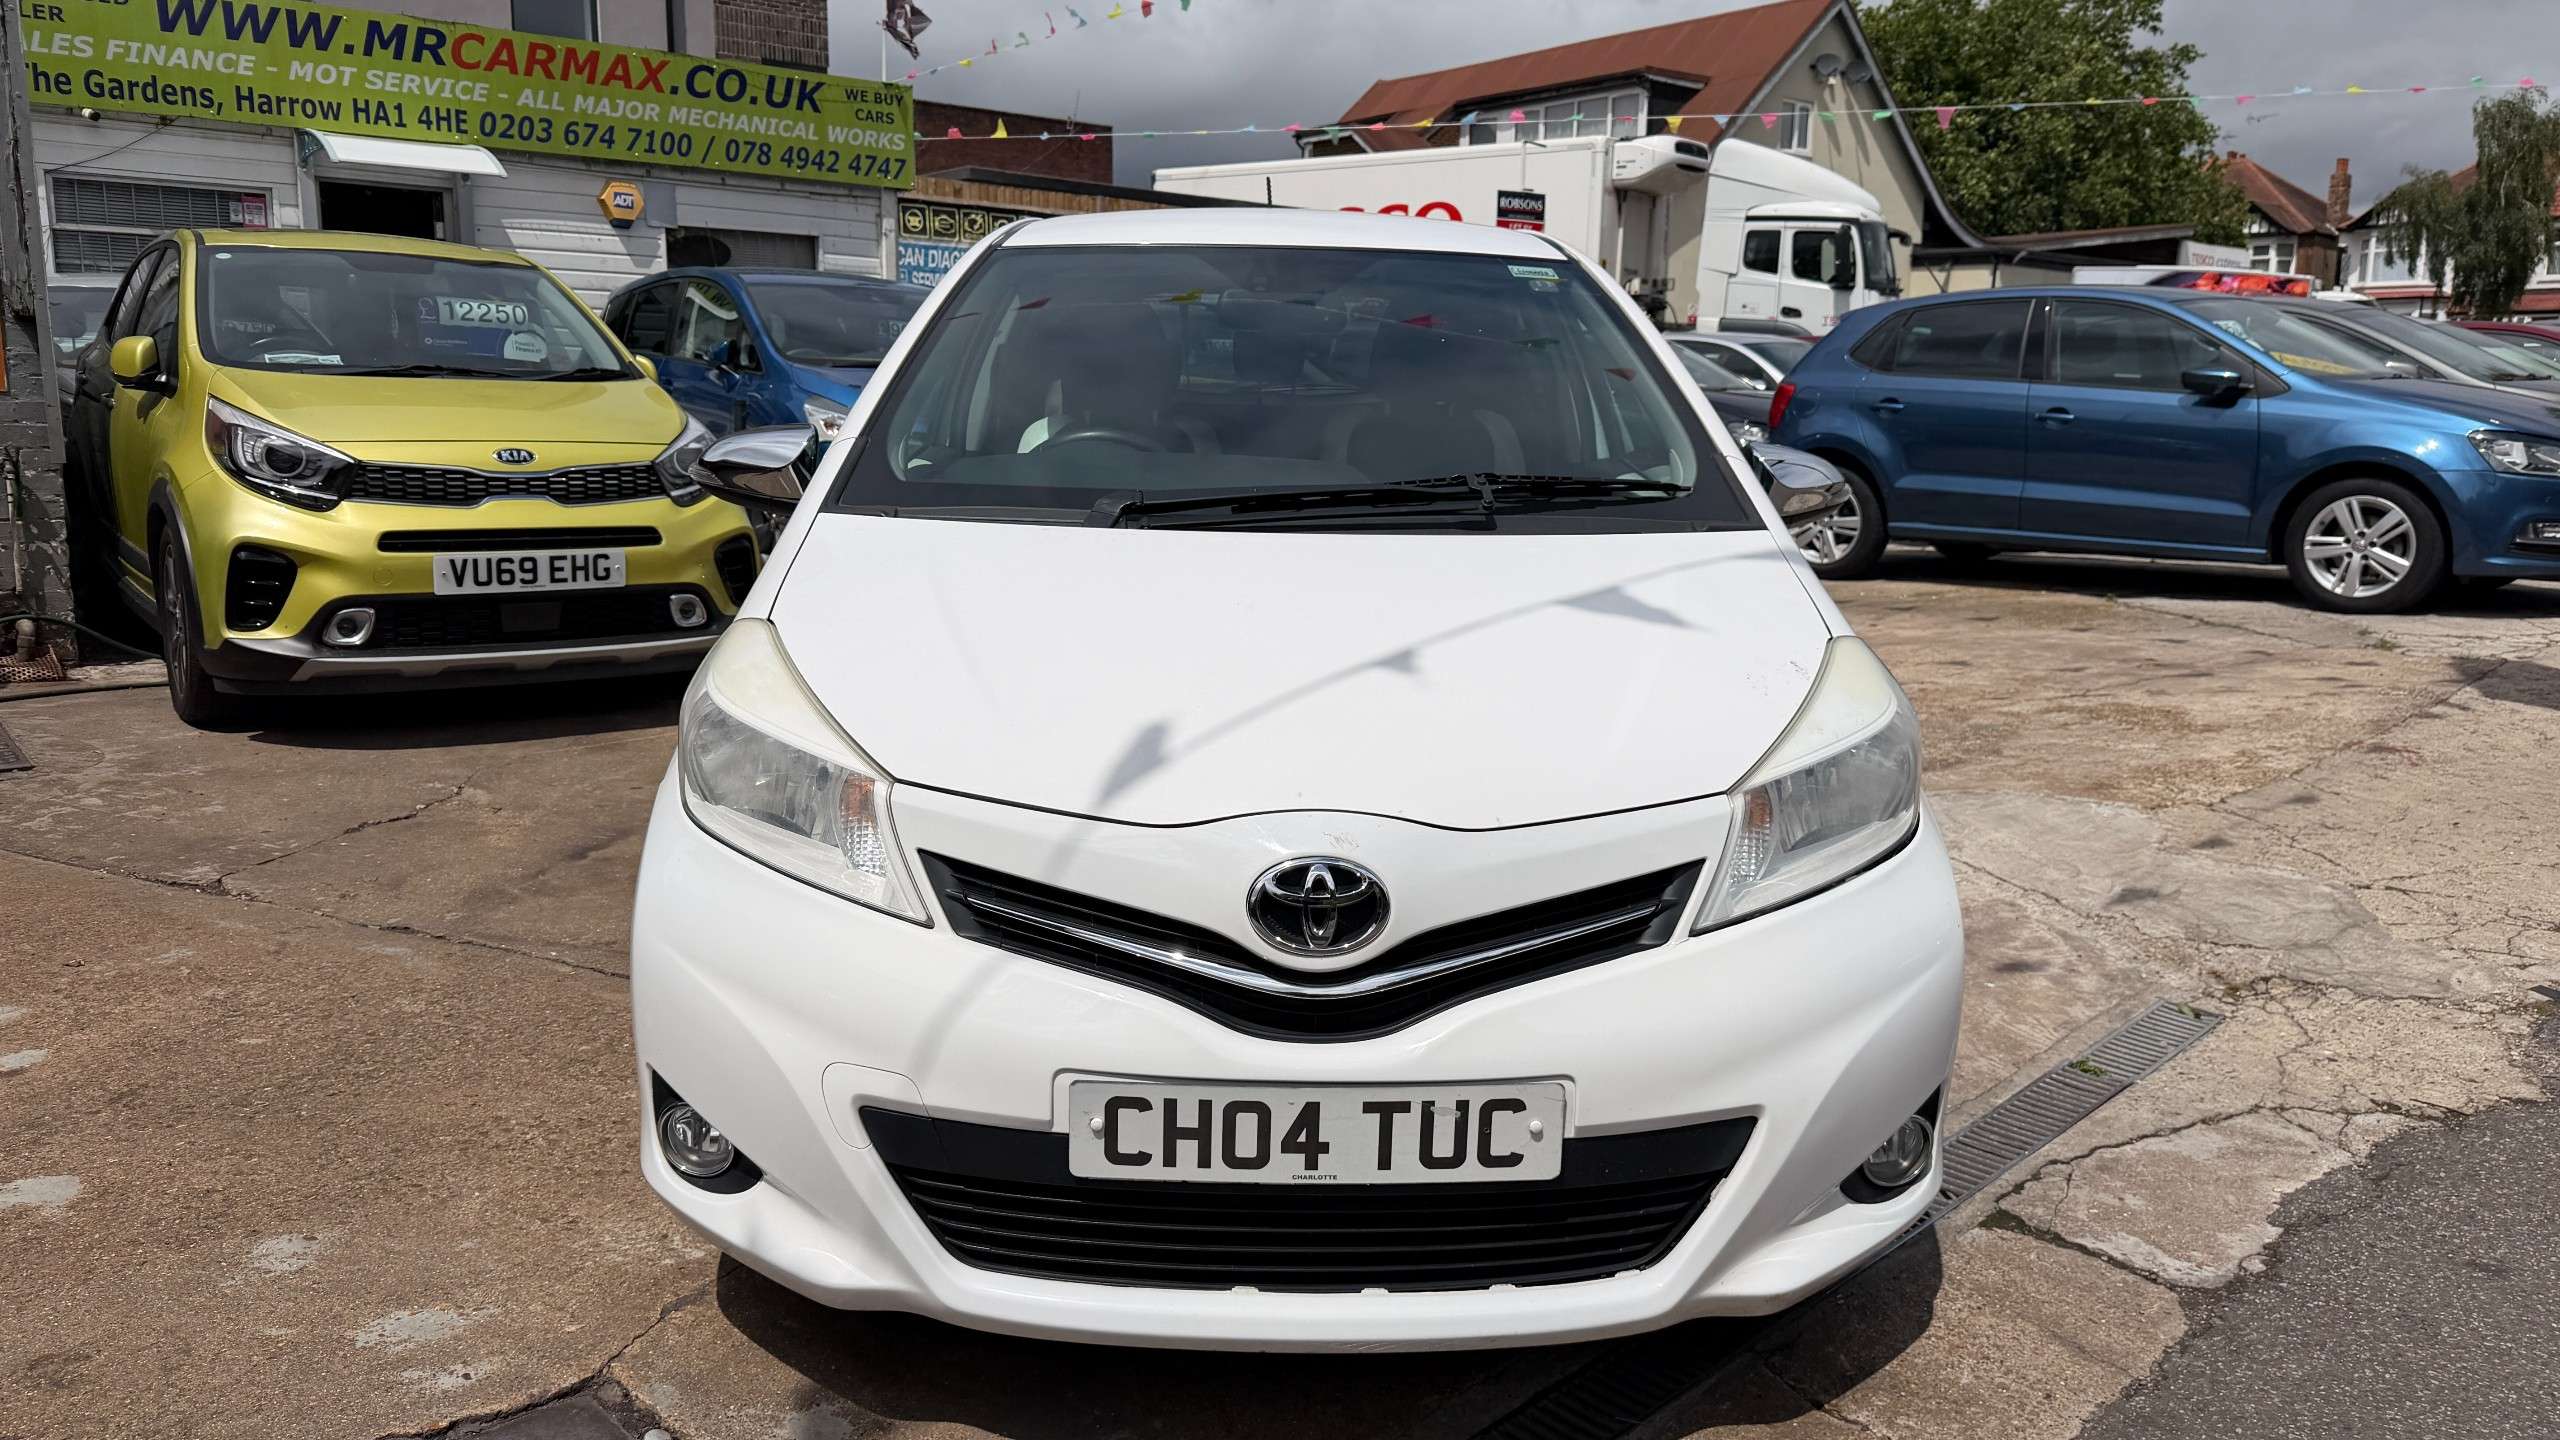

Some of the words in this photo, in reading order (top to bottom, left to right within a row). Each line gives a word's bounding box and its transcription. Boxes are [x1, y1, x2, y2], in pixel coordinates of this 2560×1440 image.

[157, 0, 826, 114] WWW.MRCARMAX.CO.UK
[105, 39, 257, 76] FINANCE
[288, 60, 358, 87] MOT
[364, 69, 491, 102] SERVICE
[516, 88, 565, 112] ALL
[573, 94, 661, 122] MAJOR
[668, 105, 818, 141] MECHANICAL
[827, 125, 906, 151] WORKS
[845, 88, 869, 103] WE
[874, 92, 904, 107] BUY
[24, 61, 72, 95] he
[83, 68, 223, 116] Gardens,
[235, 85, 342, 122] Harrow
[352, 97, 407, 128] HA1
[417, 105, 469, 135] 4HE
[479, 111, 553, 143] 0203
[563, 121, 616, 150] 674
[626, 127, 693, 158] 7100
[701, 135, 716, 164] /
[725, 138, 772, 166] 078
[779, 145, 840, 173] 4942
[848, 153, 907, 180] 4747
[855, 108, 895, 125] CARS
[615, 194, 633, 207] ADT
[443, 301, 527, 325] 12250
[500, 450, 531, 461] KIA
[449, 556, 538, 587] VU69
[549, 553, 611, 584] EHG
[1103, 1095, 1330, 1171] CH04
[1362, 1097, 1527, 1170] TUC
